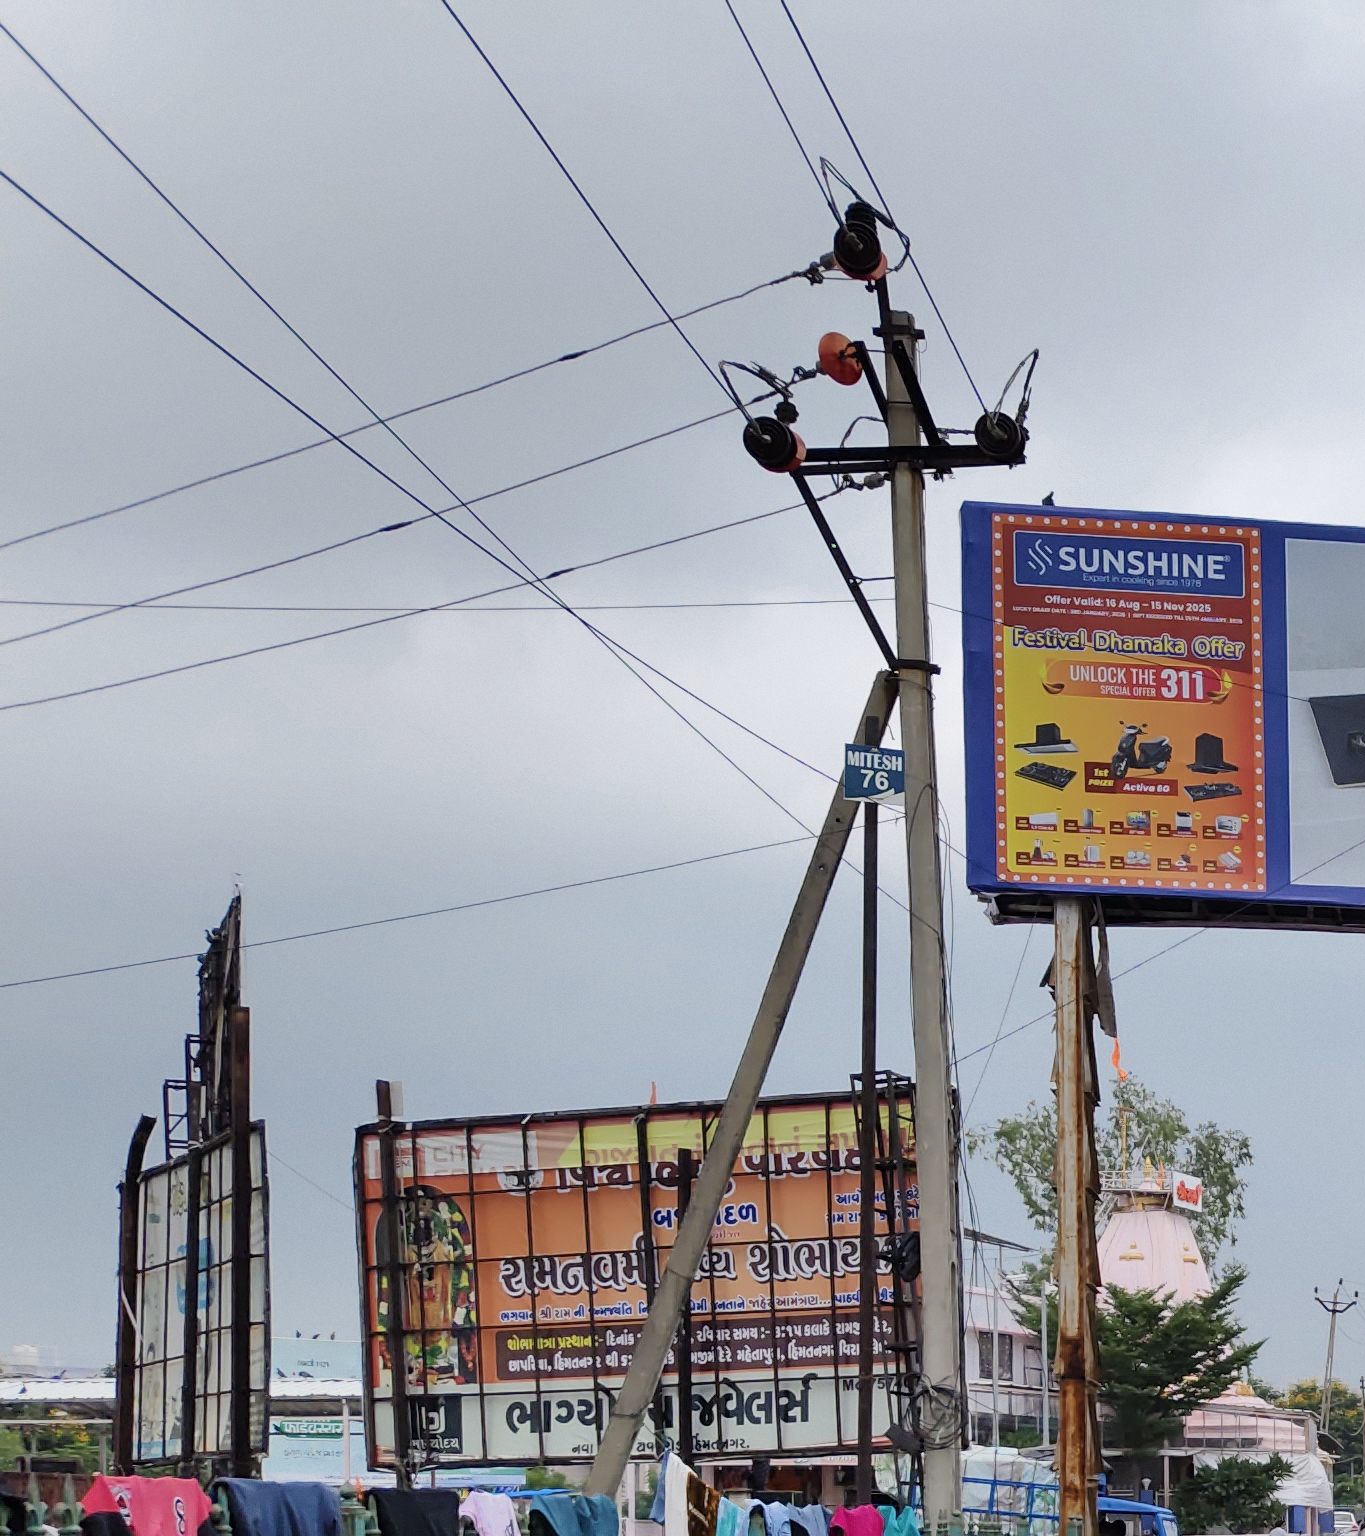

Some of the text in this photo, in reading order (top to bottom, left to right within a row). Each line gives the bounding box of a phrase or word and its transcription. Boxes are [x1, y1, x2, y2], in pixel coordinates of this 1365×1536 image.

[1083, 574, 1110, 586] Expert
[1121, 575, 1154, 588] cooking
[1156, 578, 1178, 587] since
[1180, 578, 1202, 588] 1978
[1045, 595, 1071, 605] Offer
[1072, 597, 1103, 607] Valid:
[1119, 599, 1140, 611] Aug
[1151, 601, 1162, 610] 15
[1164, 602, 1184, 611] Nov
[1186, 603, 1211, 613] 2025
[1013, 626, 1245, 659] Festival Dhamaka Offer
[1070, 664, 1204, 699] UNLOCK THE 311
[1100, 684, 1156, 698] SPECIAL OFFER
[848, 750, 903, 772] MITESH
[860, 770, 889, 790] 76
[1123, 782, 1155, 792] Activa
